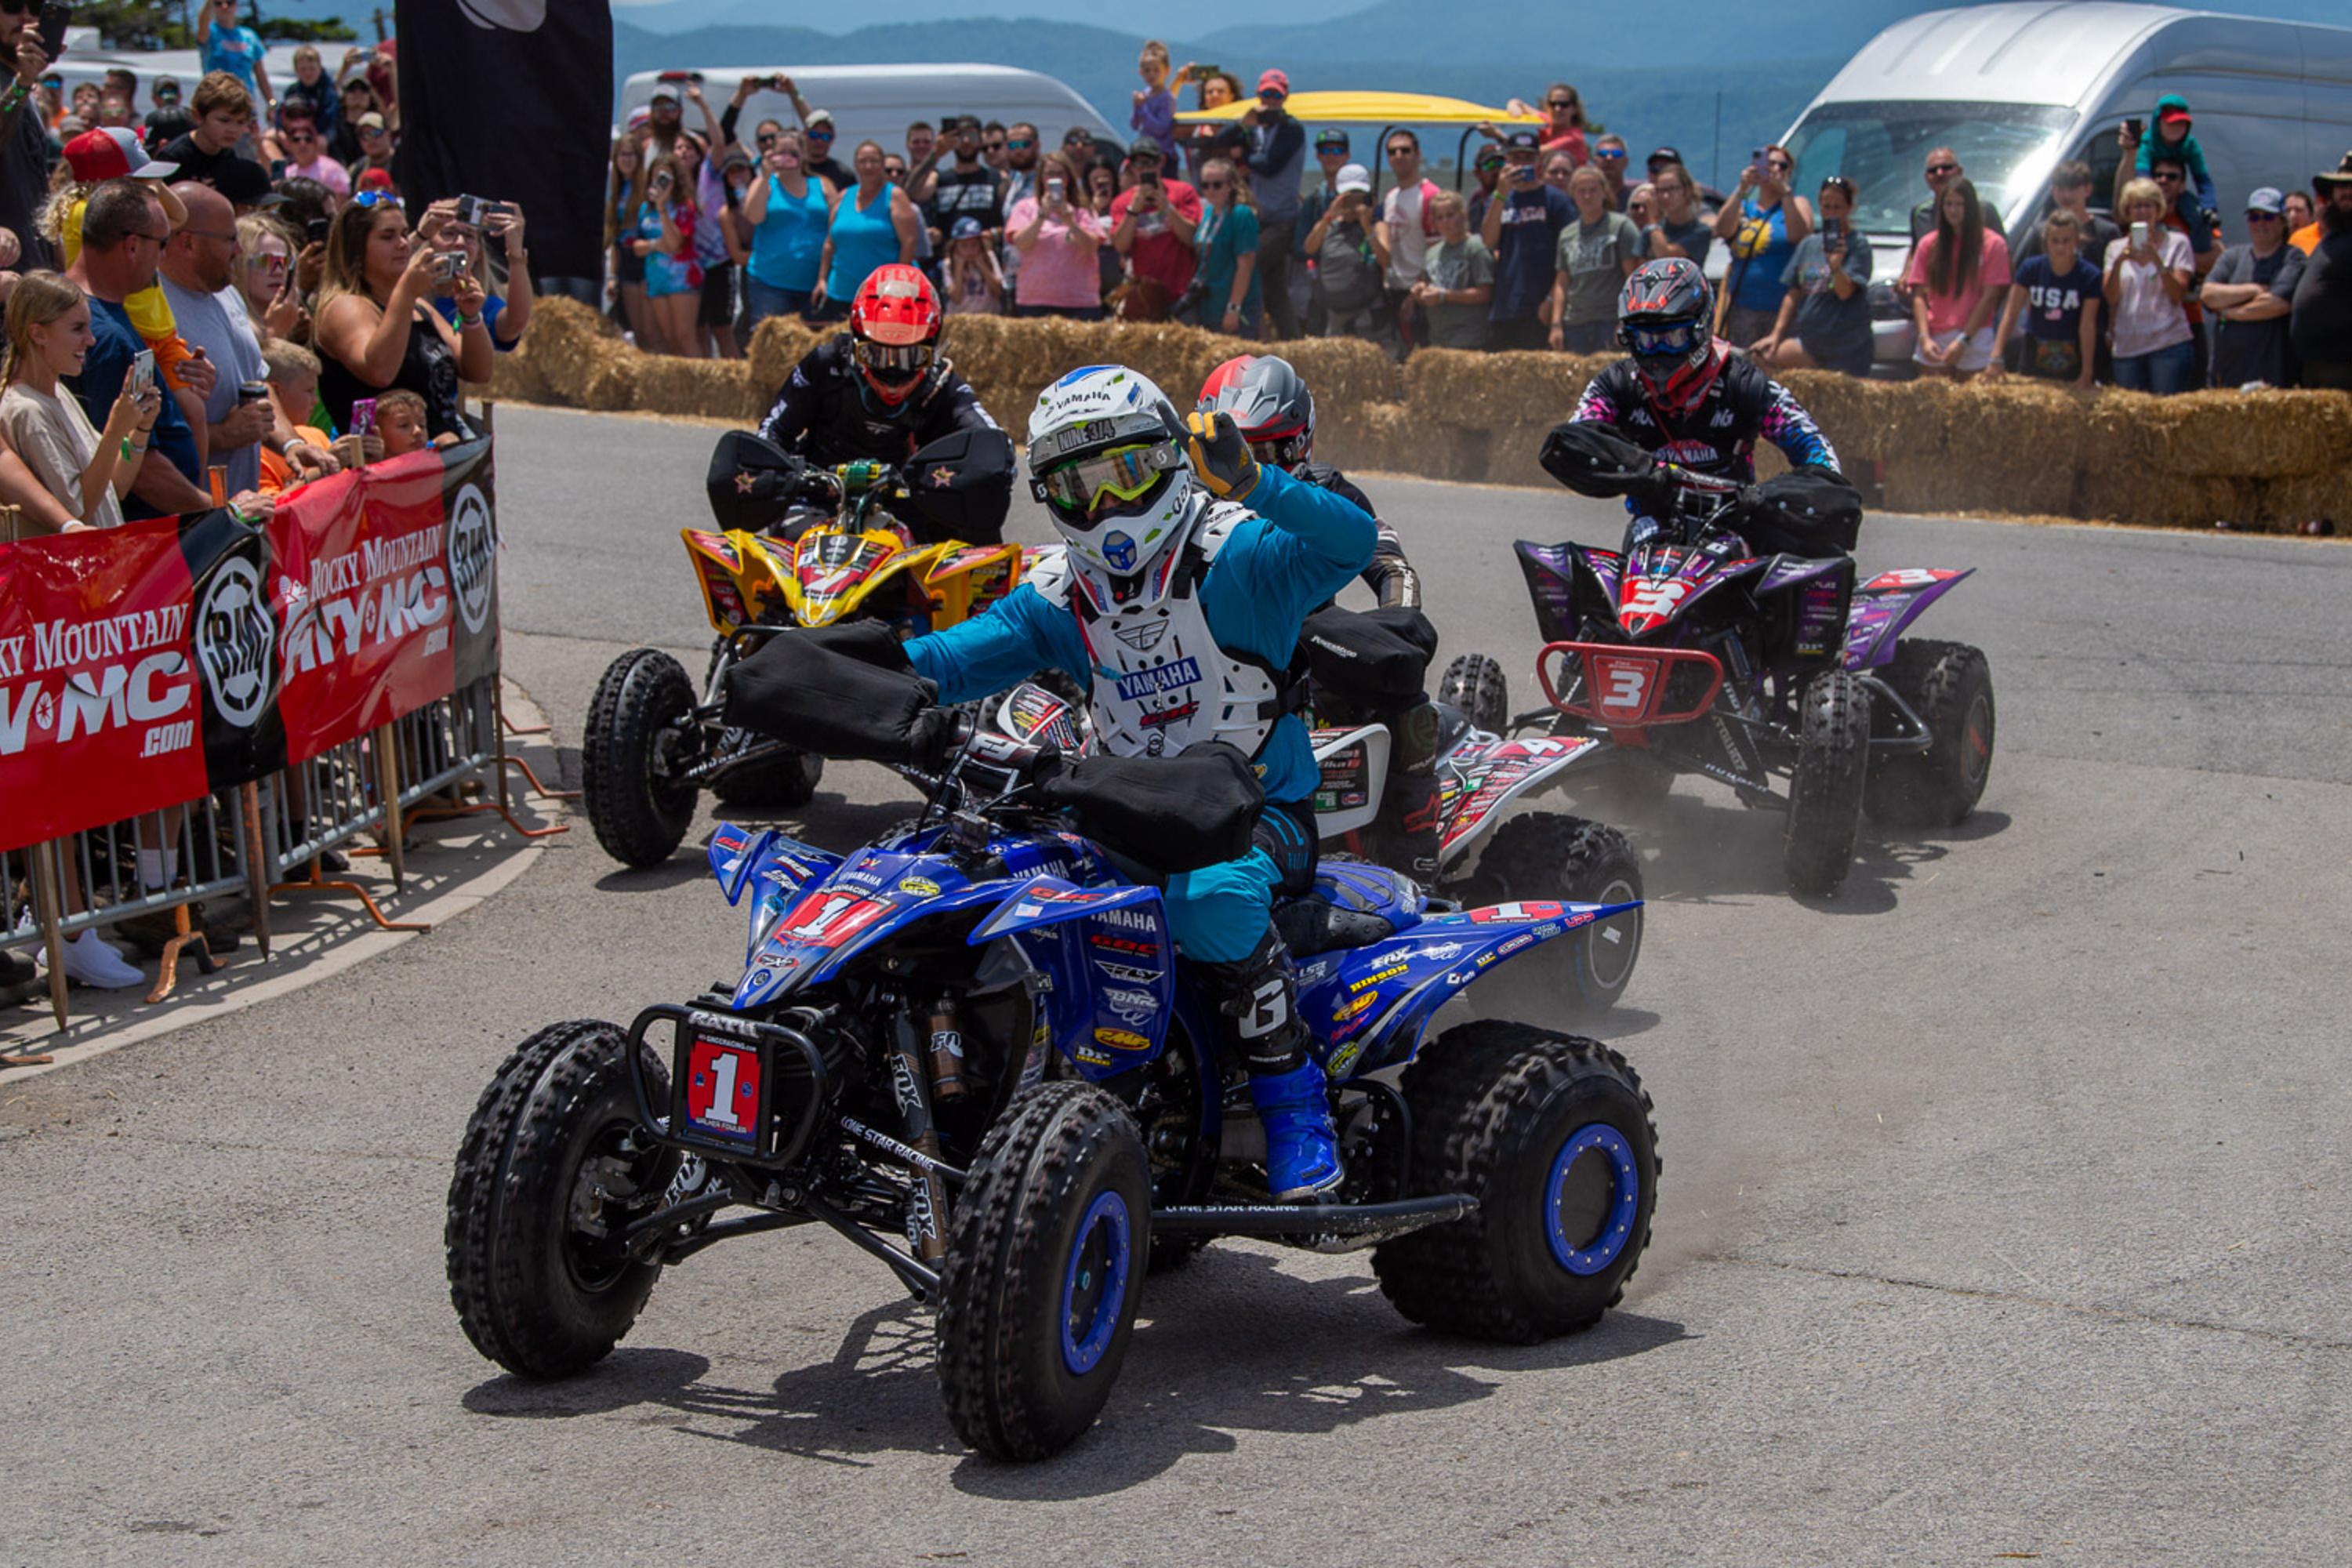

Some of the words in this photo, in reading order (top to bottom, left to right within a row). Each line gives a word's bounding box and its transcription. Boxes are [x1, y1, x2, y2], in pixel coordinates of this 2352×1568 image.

[880, 269, 920, 284] FLY
[2029, 285, 2081, 311] USA
[1055, 390, 1112, 411] YAMAHA
[1058, 424, 1089, 452] NINE
[1087, 418, 1116, 443] 3/4
[310, 552, 360, 603] ROCKY
[362, 524, 442, 583] MOUNTAIN
[1620, 579, 1686, 618] 3
[33, 603, 189, 673] MOUNTAIN
[1121, 660, 1198, 698] YAMAHA
[1603, 670, 1646, 708] 3
[1518, 739, 1564, 755] 4
[789, 895, 854, 936] 1
[1091, 909, 1157, 932] YAMAHA
[1490, 902, 1534, 919] 1
[1348, 964, 1410, 994] HINSON
[705, 1052, 740, 1125] 1
[890, 1053, 924, 1117] FOX
[840, 1116, 866, 1136] LONE
[864, 1128, 893, 1152] STAR
[894, 1144, 935, 1173] RACING
[911, 1177, 938, 1240] FOX
